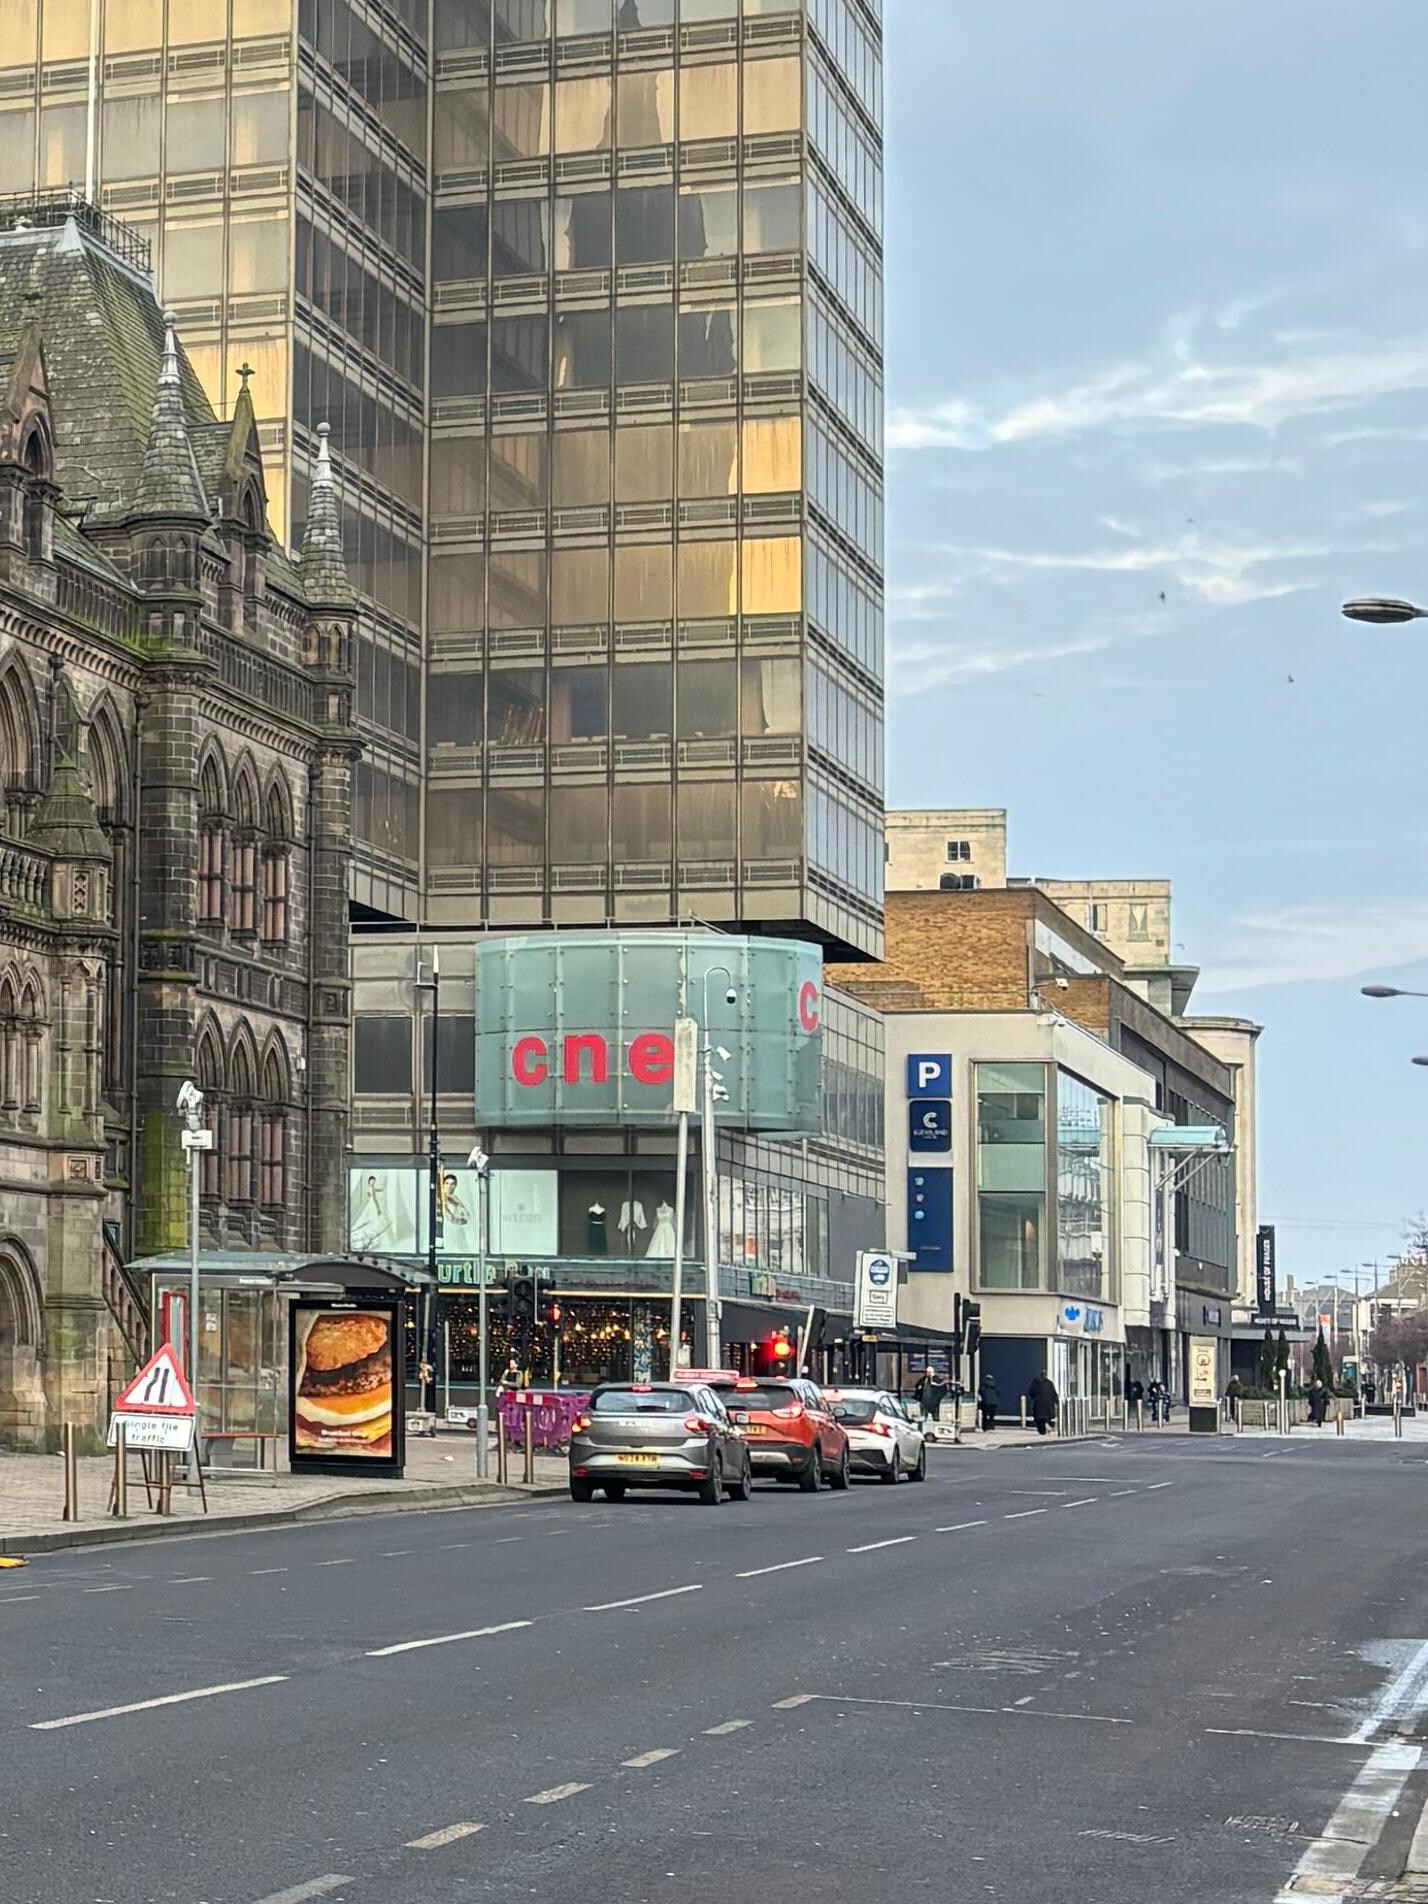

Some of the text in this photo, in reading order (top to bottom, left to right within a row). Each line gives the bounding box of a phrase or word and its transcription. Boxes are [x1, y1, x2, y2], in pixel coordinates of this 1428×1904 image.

[511, 1032, 675, 1088] cne
[918, 1061, 942, 1089] P
[437, 1259, 497, 1285] urtle
